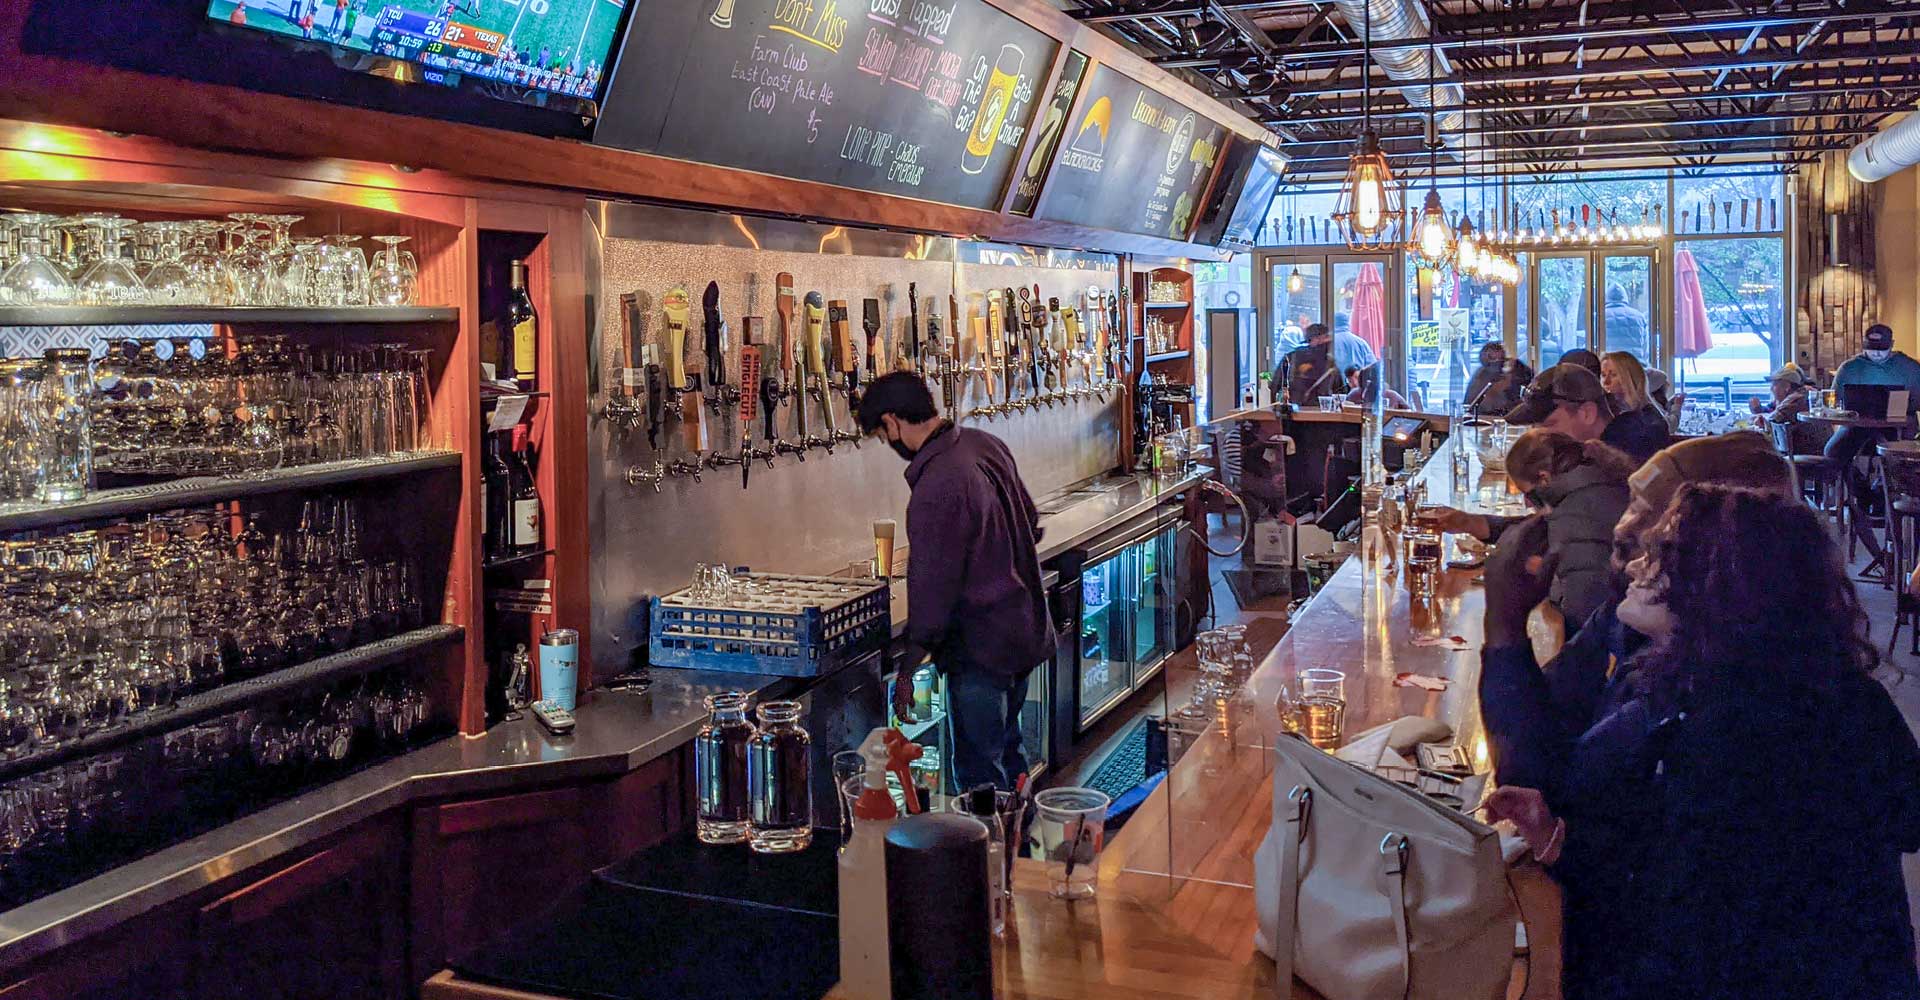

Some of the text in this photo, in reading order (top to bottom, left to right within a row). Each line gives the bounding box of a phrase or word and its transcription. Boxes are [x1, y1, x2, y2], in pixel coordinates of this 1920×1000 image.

[388, 9, 441, 36] TCU 26
[445, 26, 498, 44] 21 TEXAS
[812, 0, 848, 48] Miss
[378, 31, 393, 41] 4TH
[399, 36, 422, 48] 10:59
[457, 48, 471, 59] 2ND
[476, 53, 482, 61] 6
[751, 34, 808, 72] Farm Club
[424, 71, 443, 82] VIZIO
[731, 60, 834, 105] East Coast Pale Ale
[973, 55, 988, 85] On
[962, 78, 982, 105] The
[1013, 73, 1033, 103] Grab
[955, 105, 976, 133] Go?
[1009, 101, 1020, 121] A
